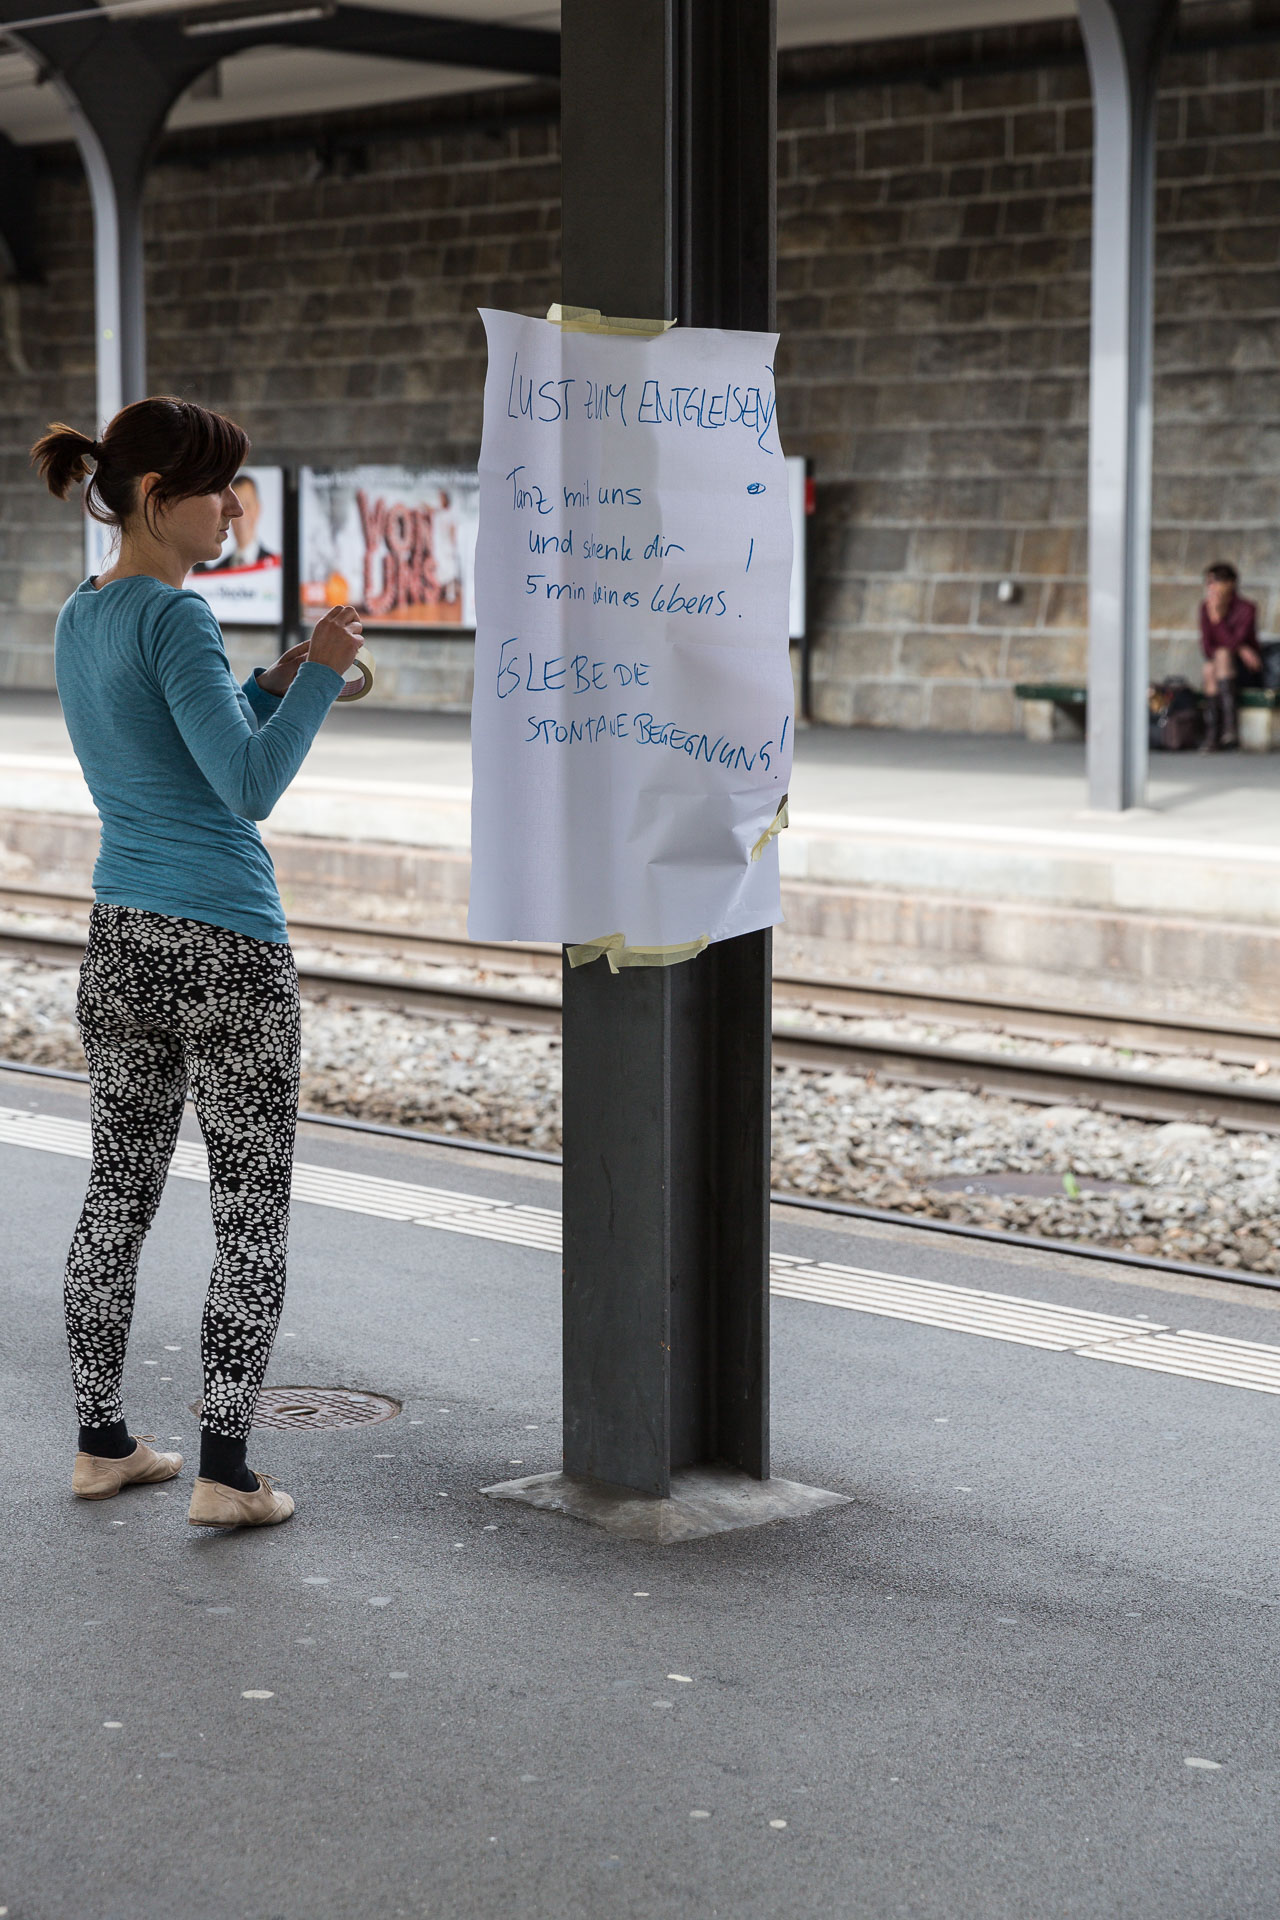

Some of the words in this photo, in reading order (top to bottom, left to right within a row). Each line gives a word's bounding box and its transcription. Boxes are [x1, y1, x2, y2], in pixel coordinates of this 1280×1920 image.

[507, 351, 576, 422] LUST
[506, 465, 554, 515] Tanz
[563, 479, 590, 508] mit
[598, 486, 643, 506] uns
[643, 534, 686, 560] dir
[525, 574, 547, 595] 5
[546, 581, 585, 600] min
